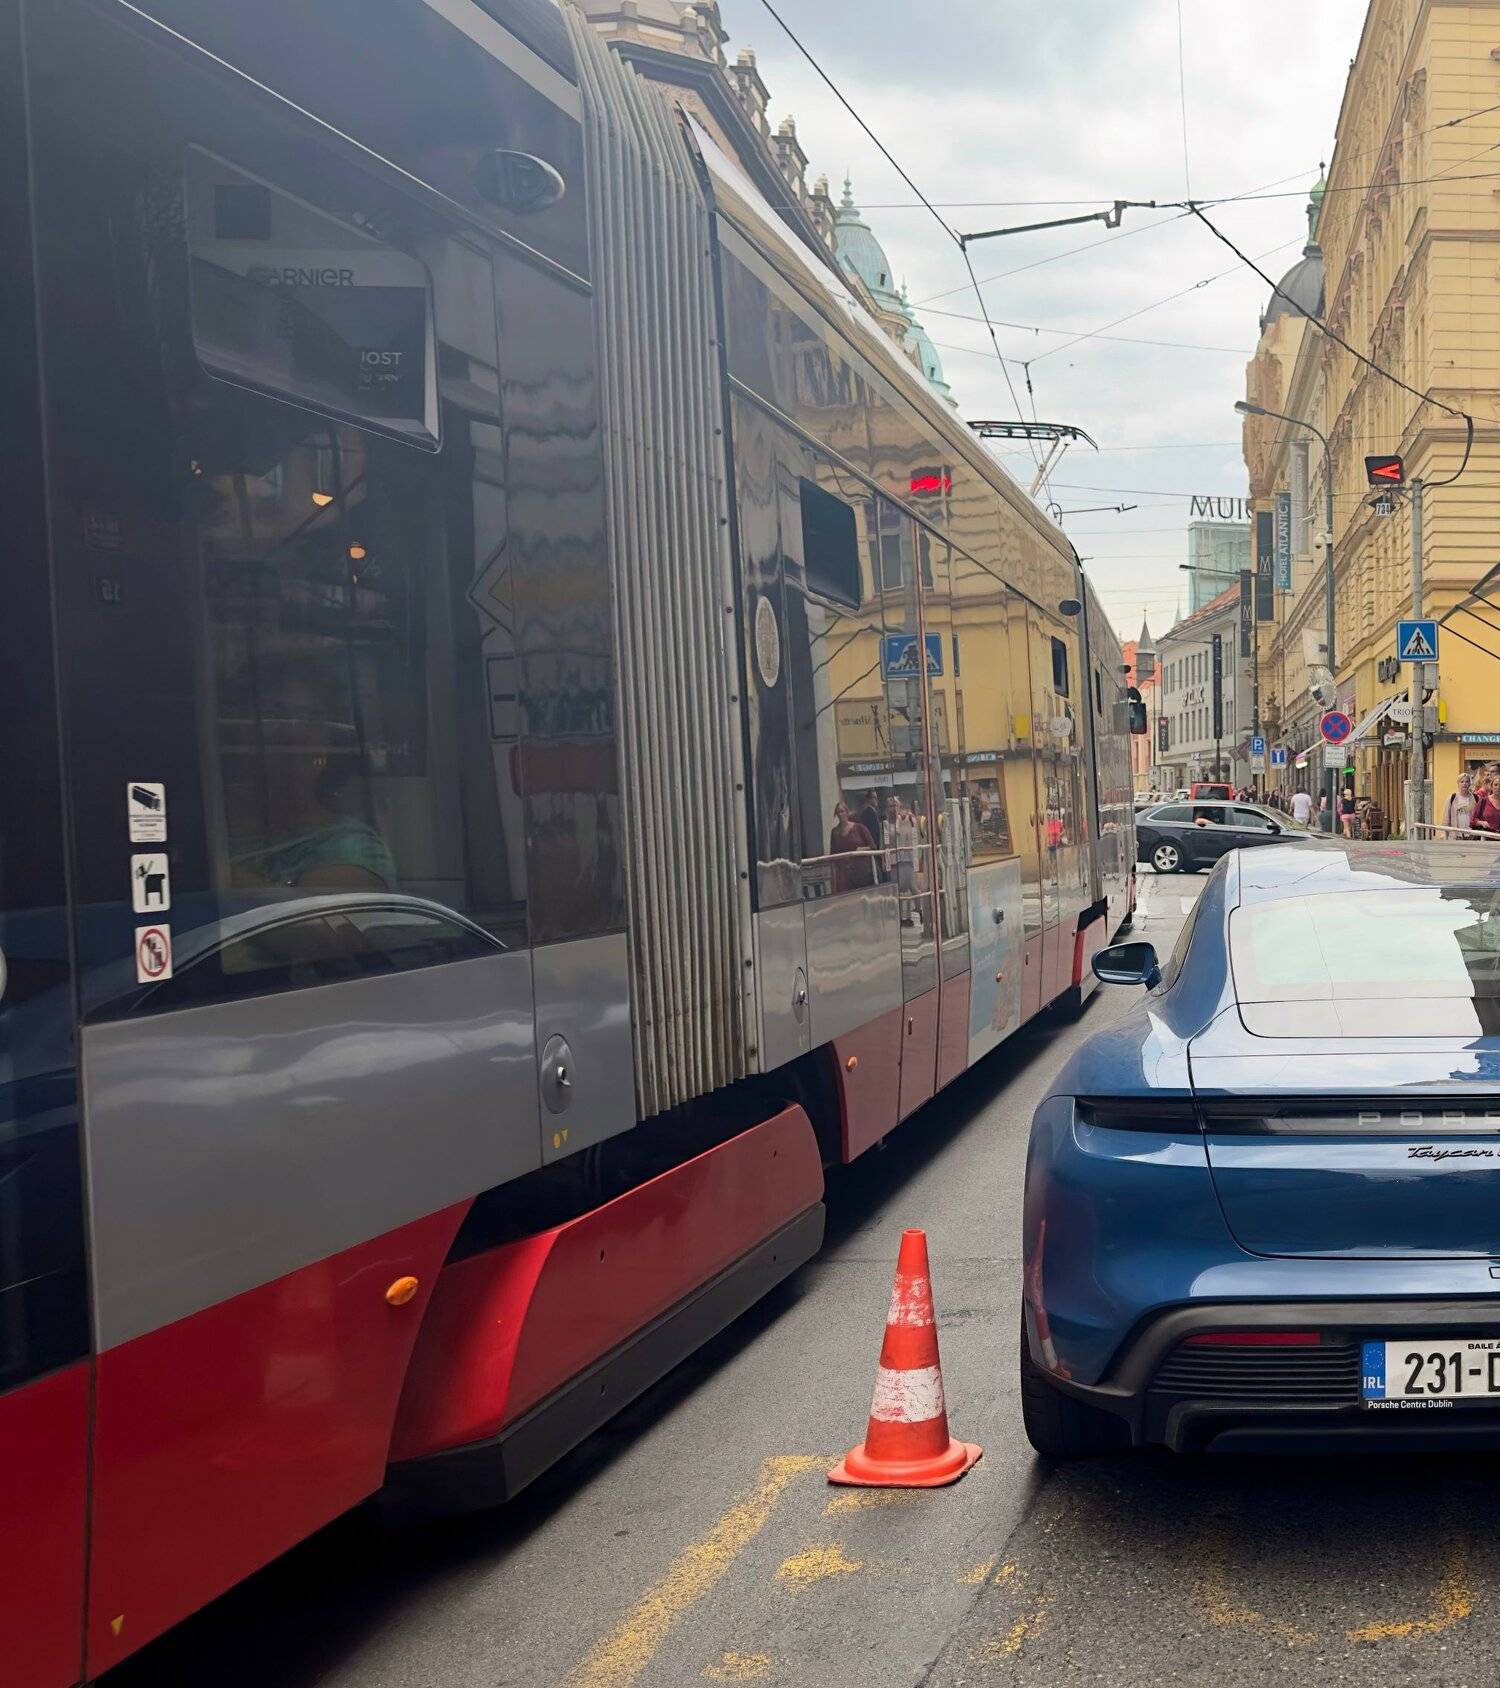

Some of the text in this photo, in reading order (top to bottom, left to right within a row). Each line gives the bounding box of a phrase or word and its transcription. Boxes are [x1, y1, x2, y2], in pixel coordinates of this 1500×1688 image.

[1278, 503, 1289, 553] ATLANTIC
[1363, 1376, 1385, 1389] IRL
[1368, 1399, 1453, 1409] Porsche Centre Dublin
